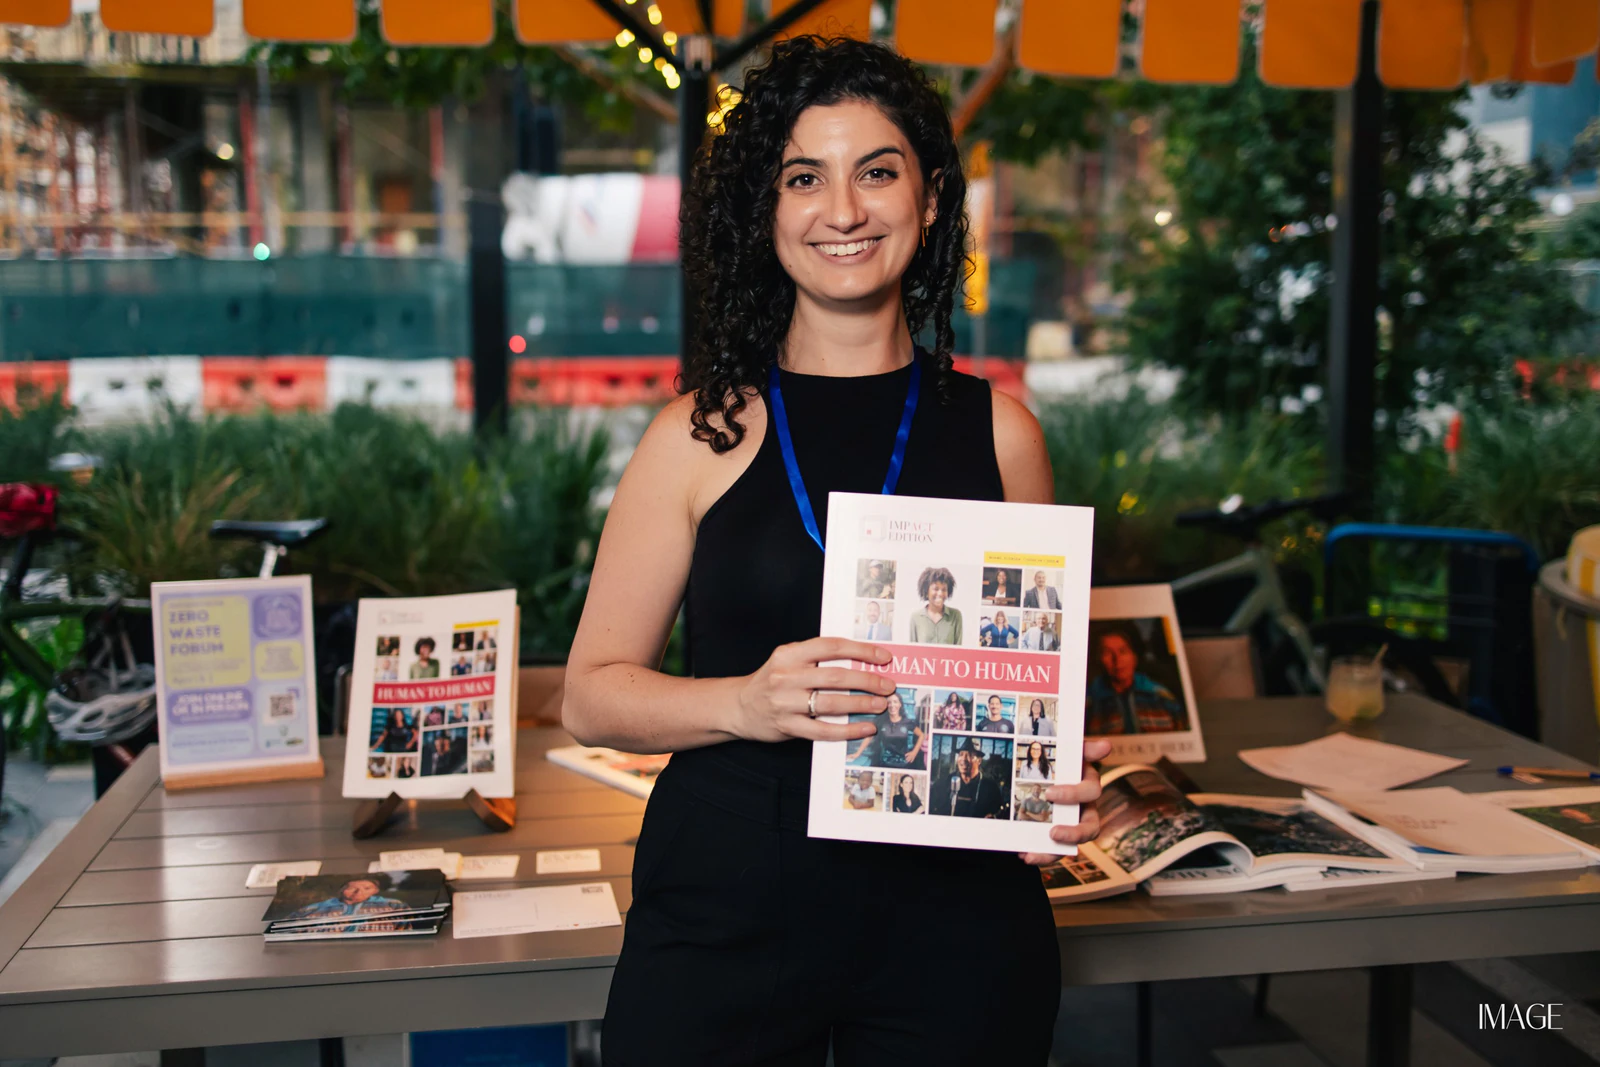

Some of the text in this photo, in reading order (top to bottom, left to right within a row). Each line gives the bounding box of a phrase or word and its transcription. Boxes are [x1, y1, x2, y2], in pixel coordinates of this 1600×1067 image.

[889, 520, 935, 532] IMPACT
[888, 531, 934, 543] EDITION
[168, 609, 209, 624] ZERO
[169, 625, 221, 639] WASTE
[170, 641, 224, 656] FORUM
[940, 659, 970, 678] TO
[974, 661, 1052, 684] HUMAN
[377, 680, 491, 700] HUMAN TO HUMAN
